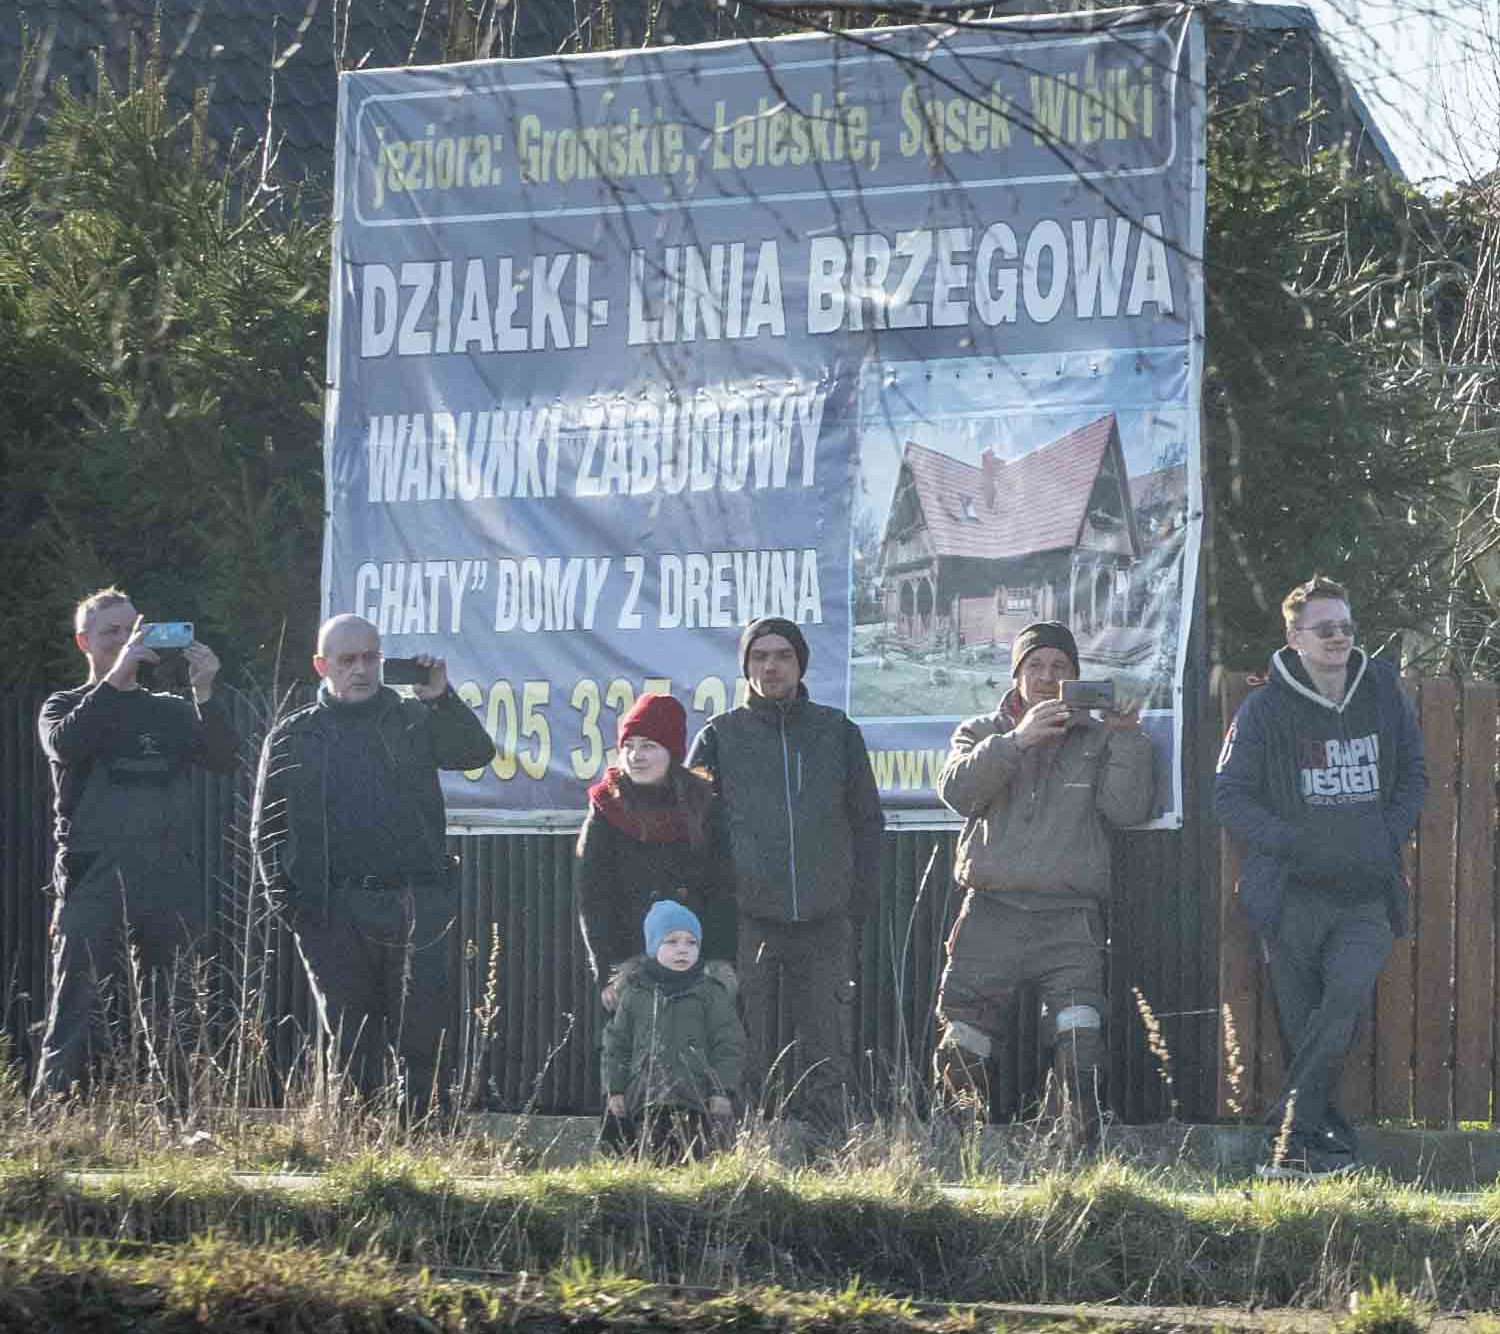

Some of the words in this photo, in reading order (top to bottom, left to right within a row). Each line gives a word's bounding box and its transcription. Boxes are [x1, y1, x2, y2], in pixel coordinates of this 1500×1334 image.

[901, 82, 1013, 157] Sasek
[626, 239, 786, 346] LINIA
[807, 214, 1175, 335] BRZEGOWA
[367, 407, 562, 503] WARUNKI
[576, 393, 827, 497] ZABUDOWY
[495, 556, 612, 633] DOMY
[617, 555, 645, 629] Z
[658, 548, 823, 630] DREWNA
[570, 675, 673, 780] 33
